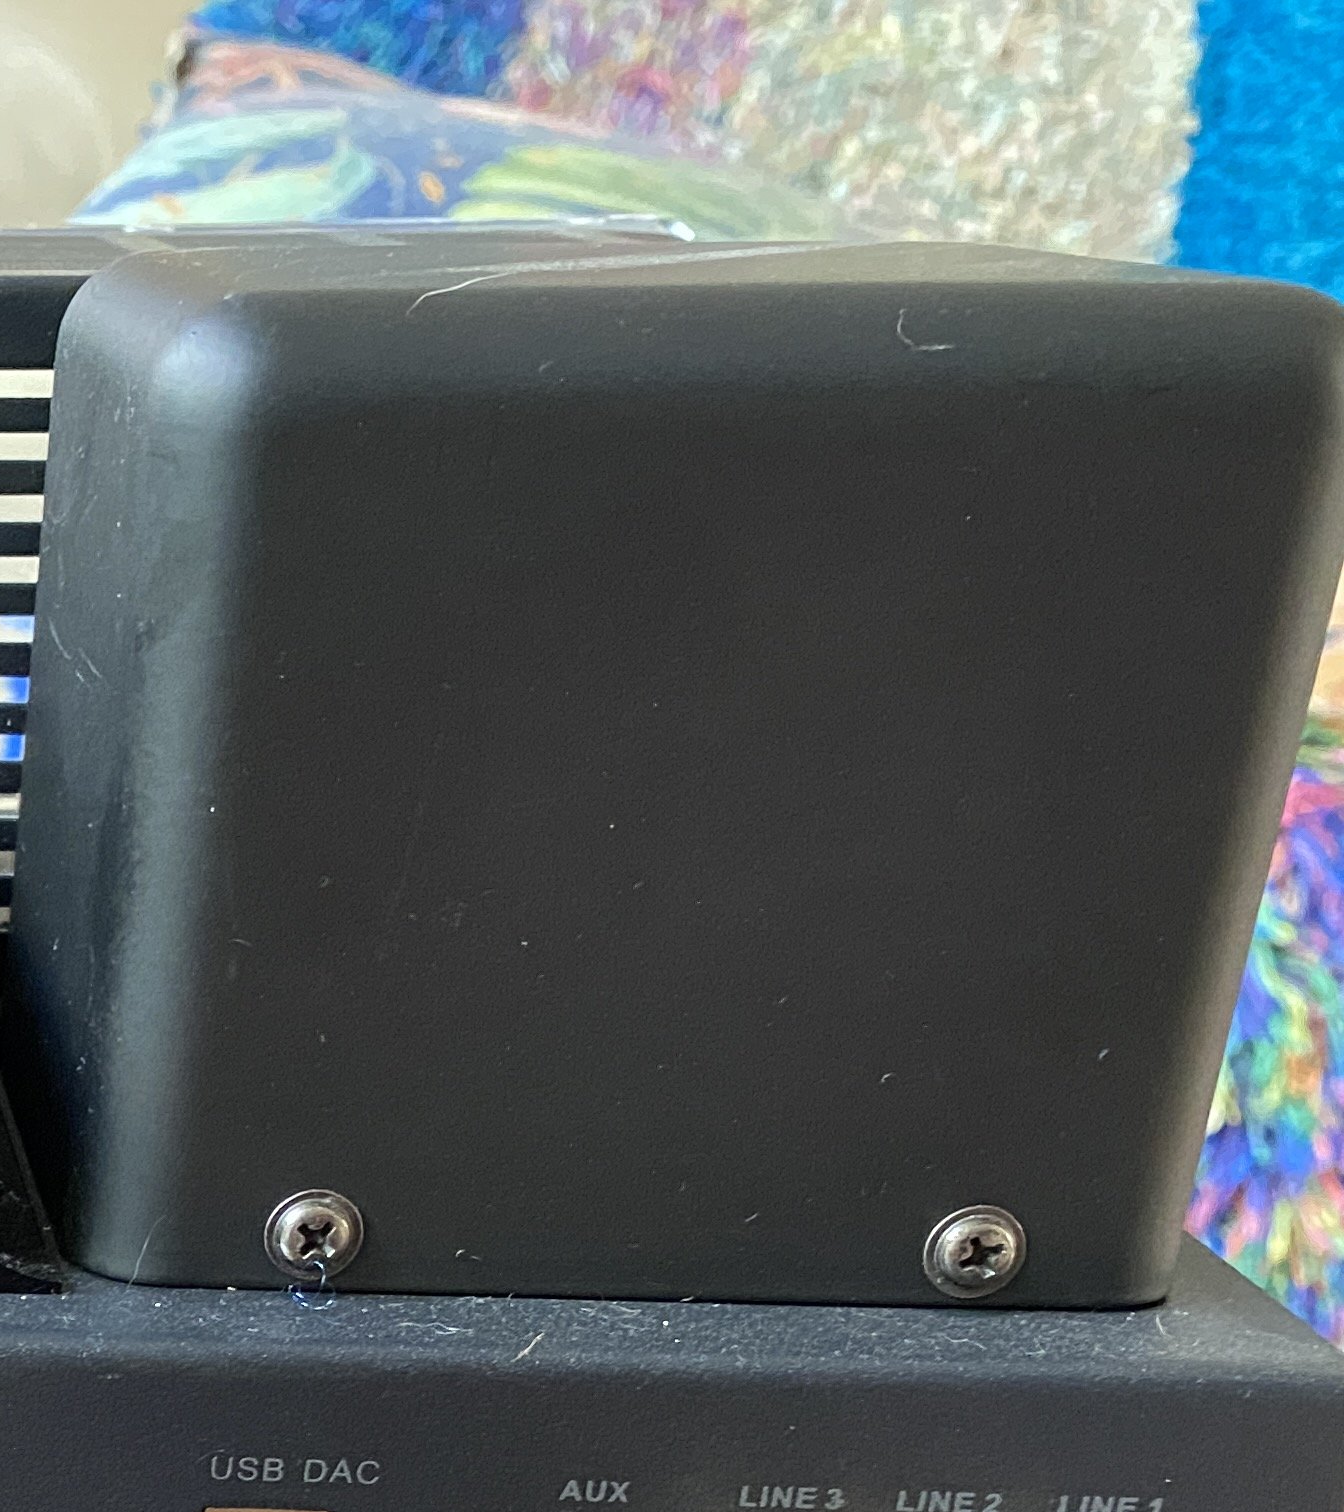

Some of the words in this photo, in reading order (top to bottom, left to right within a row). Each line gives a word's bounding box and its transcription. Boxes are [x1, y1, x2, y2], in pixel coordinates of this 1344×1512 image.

[210, 1455, 285, 1483] USB
[303, 1458, 381, 1486] DAC
[559, 1479, 631, 1504] AUX
[739, 1485, 816, 1510] LINE
[823, 1487, 847, 1511] 3
